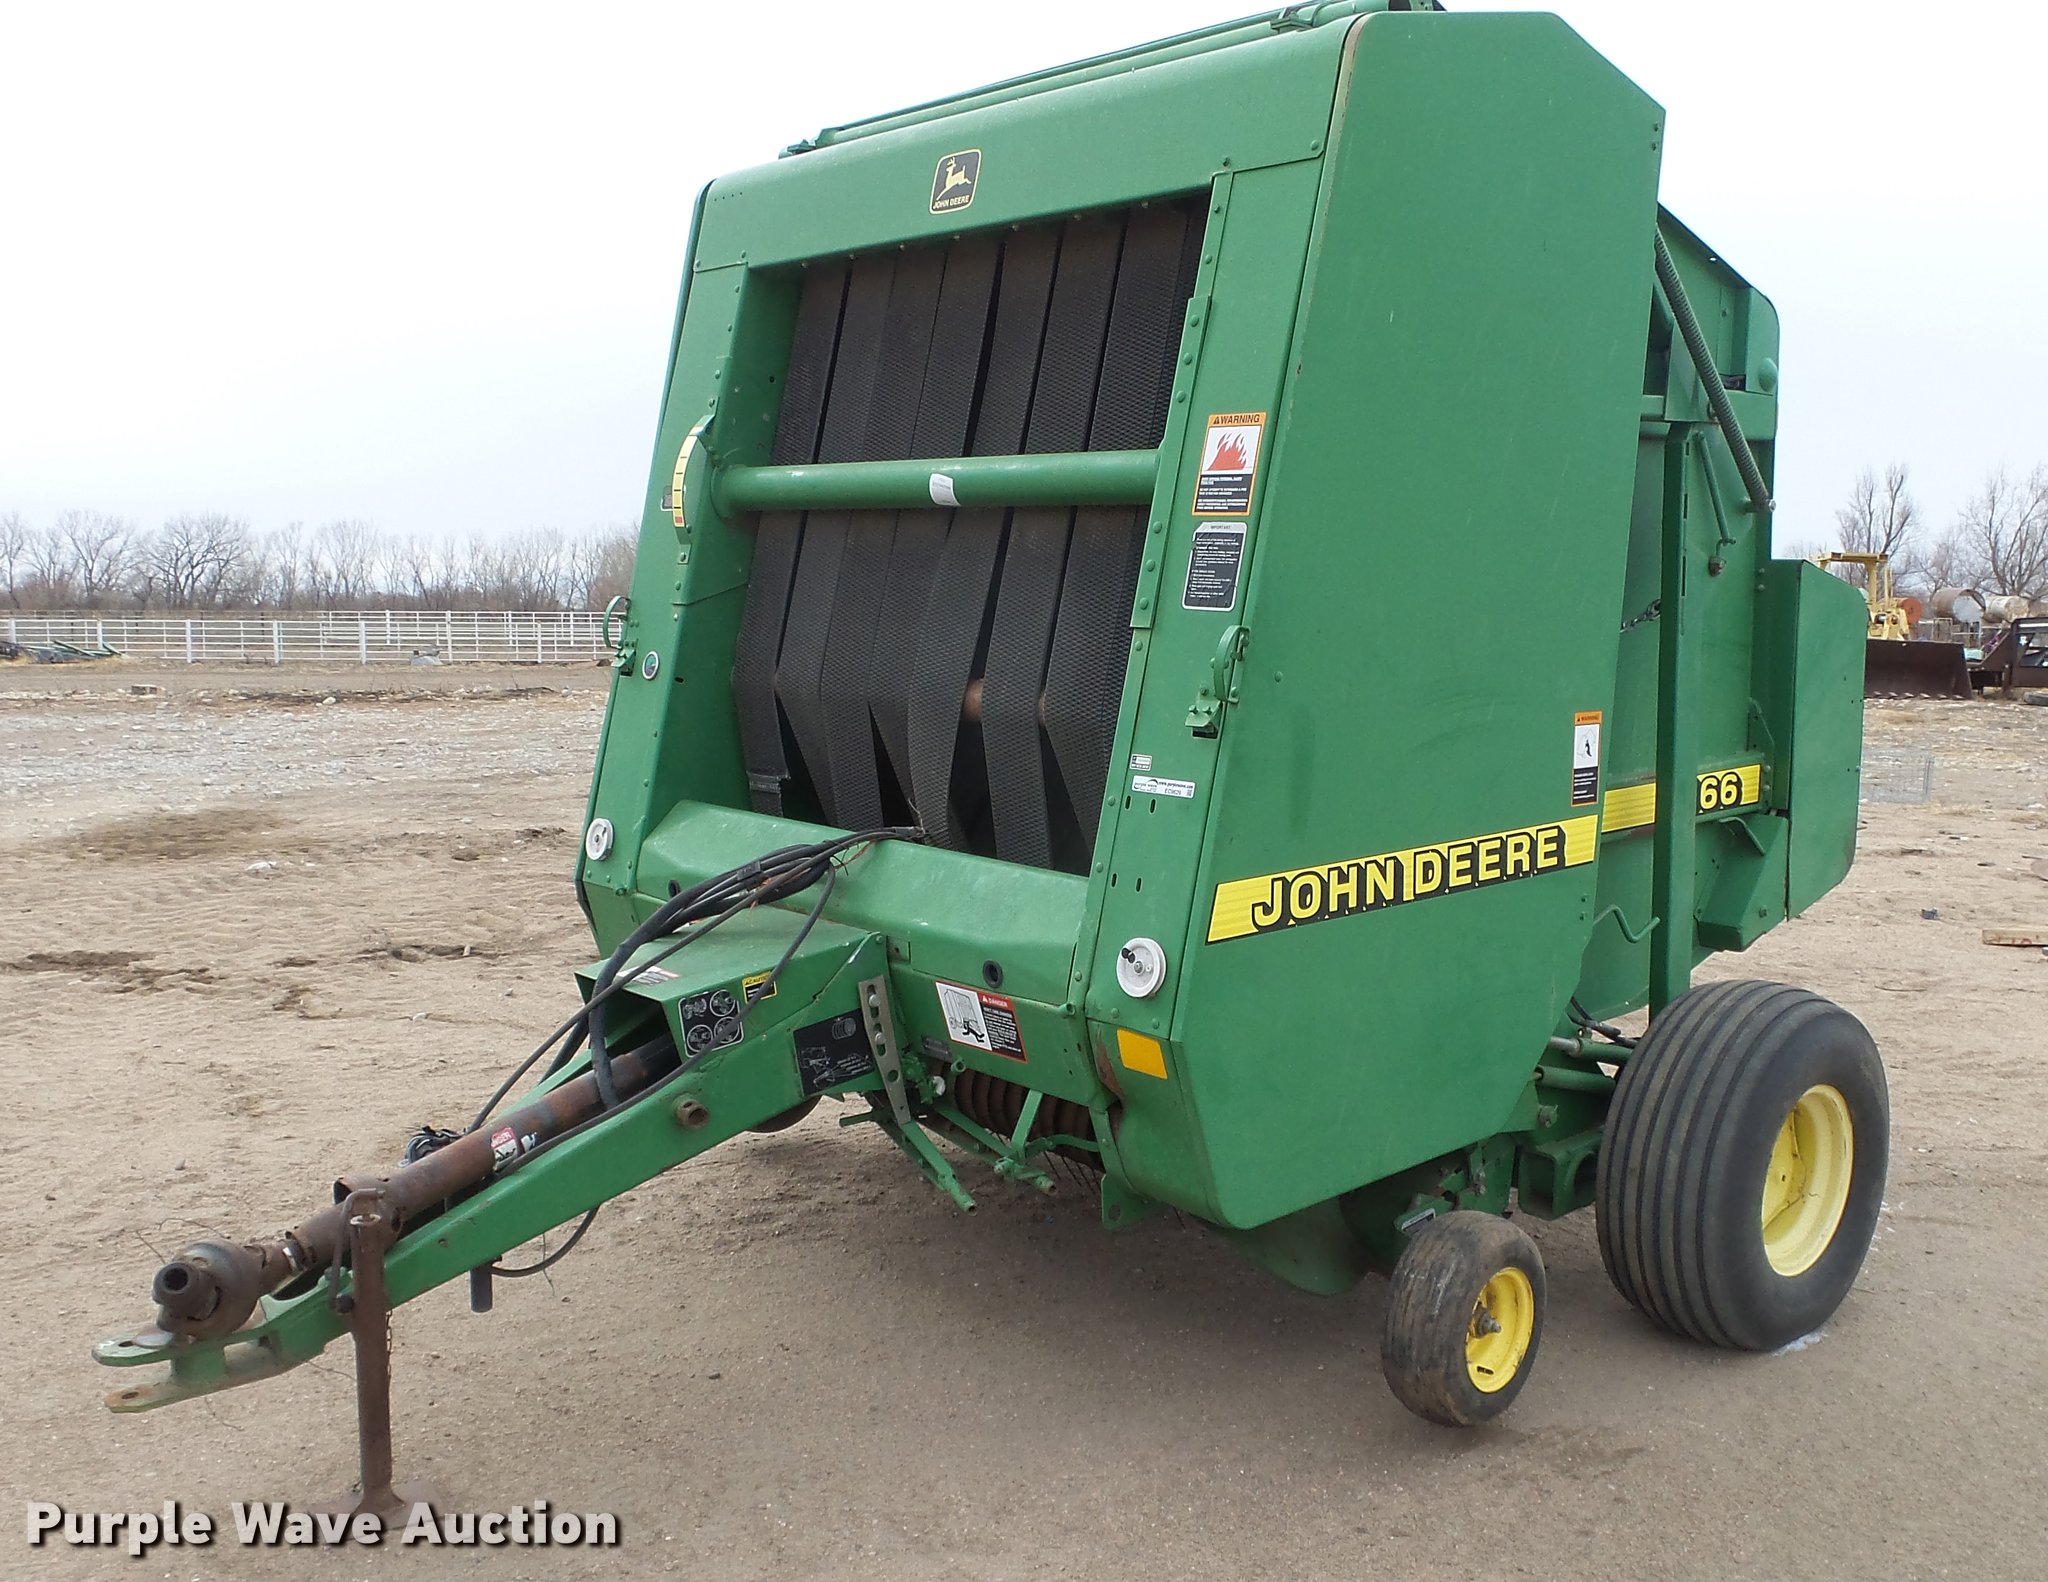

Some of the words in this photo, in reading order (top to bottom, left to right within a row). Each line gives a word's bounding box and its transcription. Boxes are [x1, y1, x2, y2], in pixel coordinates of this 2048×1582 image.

[932, 199, 950, 209] JOHN
[950, 195, 970, 205] DEERE
[1220, 414, 1260, 424] WARNING
[1252, 857, 1400, 930] JOHN
[1413, 826, 1565, 895] DEERE
